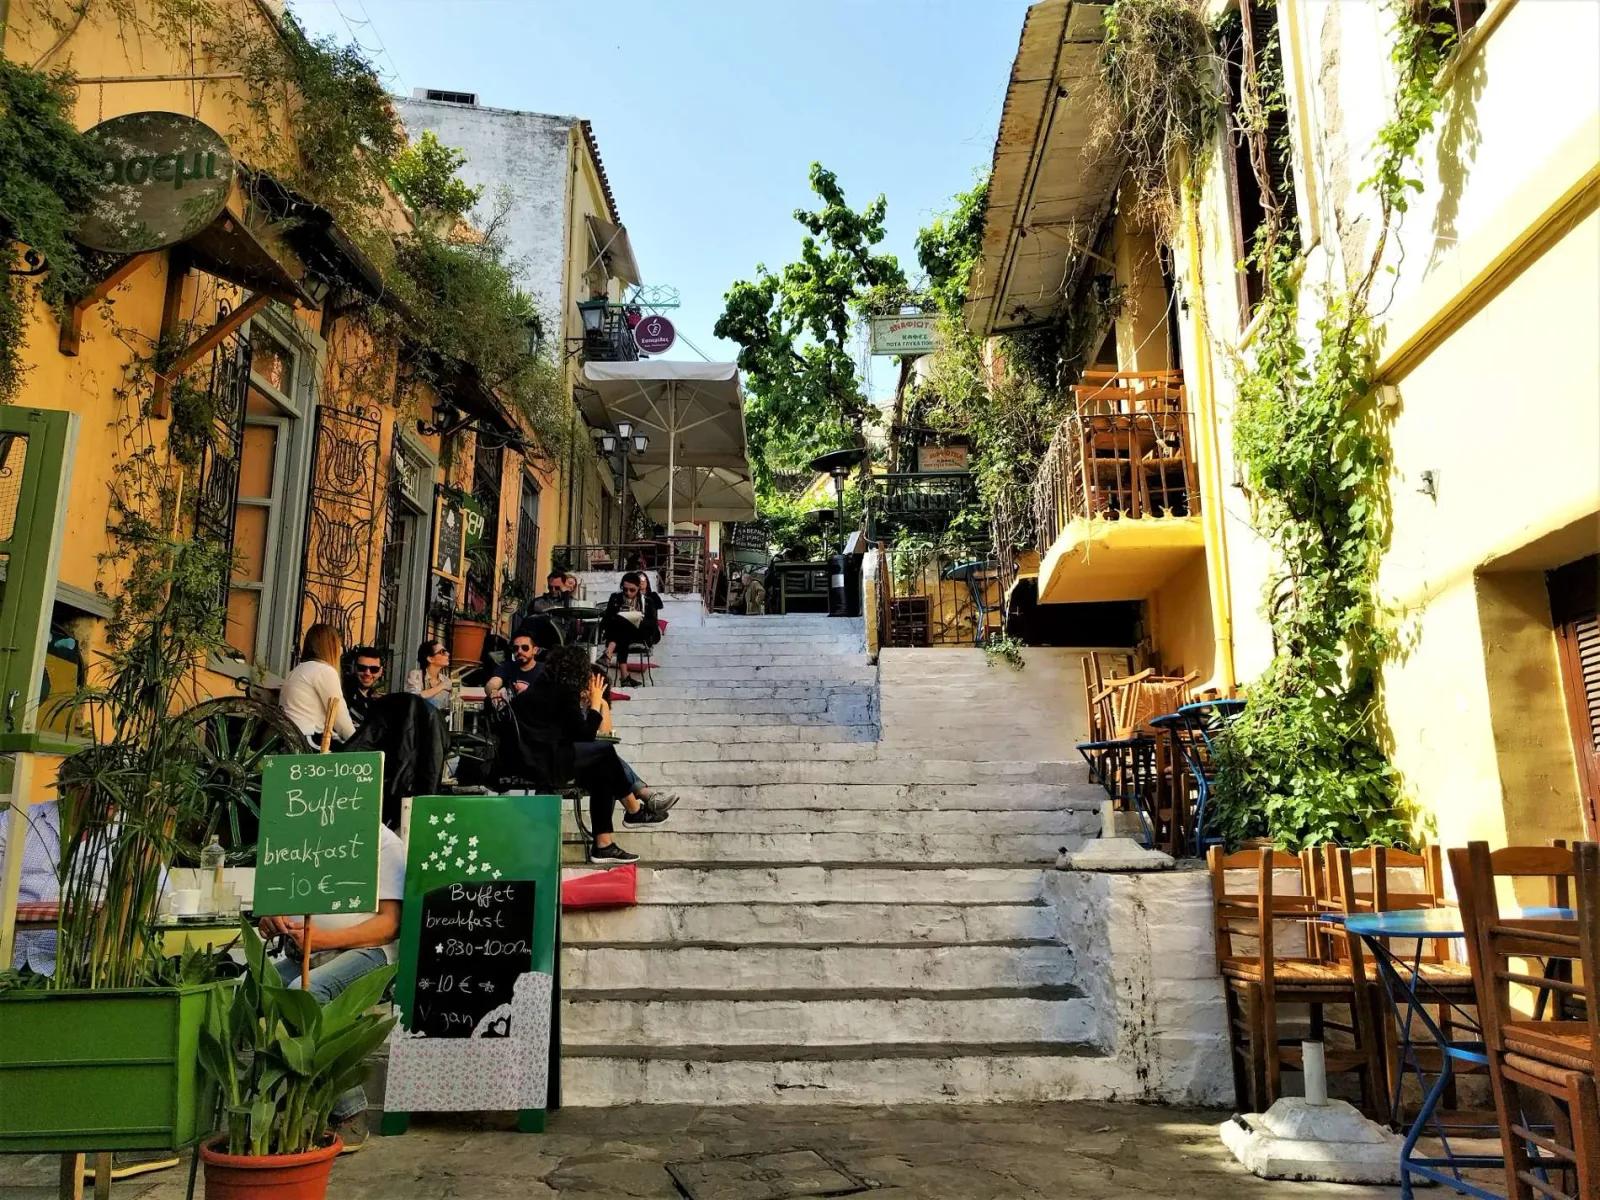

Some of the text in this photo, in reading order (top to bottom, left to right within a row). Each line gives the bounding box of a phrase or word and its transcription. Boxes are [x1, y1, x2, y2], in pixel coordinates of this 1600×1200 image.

[286, 786, 364, 827] Buffet
[263, 833, 365, 868] breakfast
[449, 883, 515, 908] Buffet
[426, 909, 504, 931] breakfast
